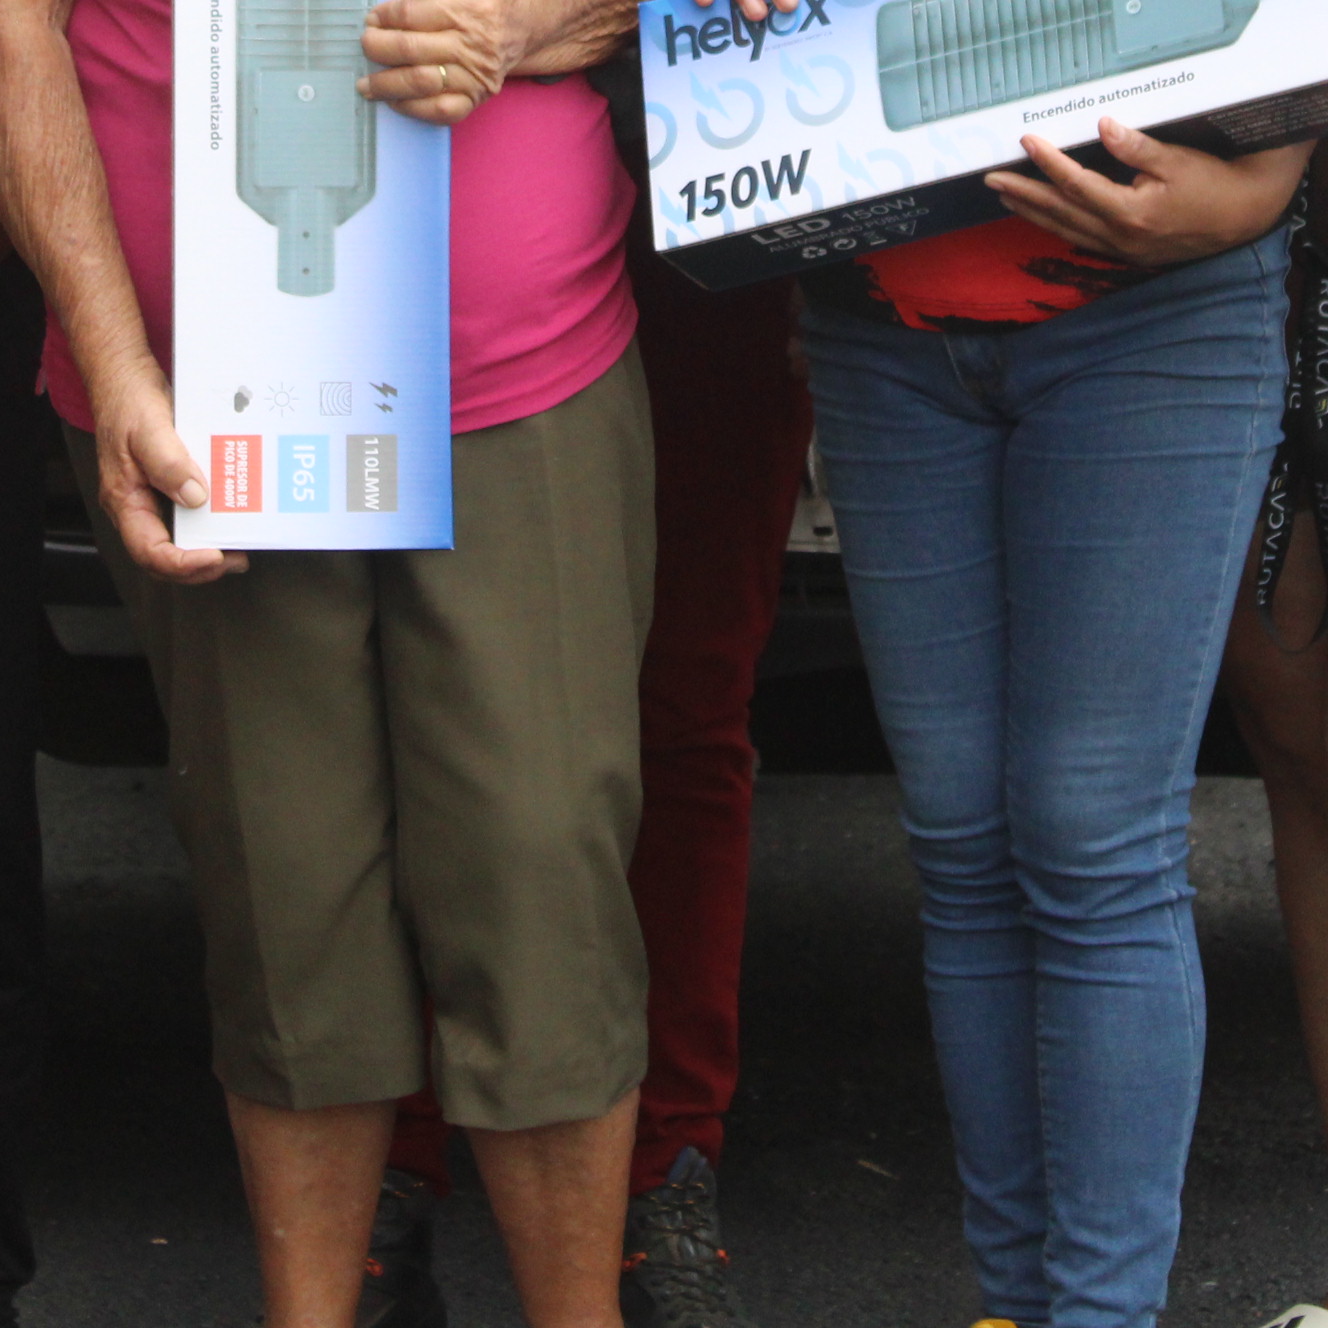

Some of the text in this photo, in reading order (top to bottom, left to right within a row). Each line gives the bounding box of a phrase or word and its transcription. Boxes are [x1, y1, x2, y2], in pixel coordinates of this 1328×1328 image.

[210, 45, 223, 151] automatizado
[1022, 71, 1196, 124] Encendido automatizado
[678, 148, 812, 222] 150W
[751, 196, 917, 245] LED 150W
[224, 440, 235, 508] PICO DE 4000V
[236, 440, 248, 508] SUPRESOR DE
[292, 445, 315, 502] IP65
[364, 437, 380, 511] 110LMW
